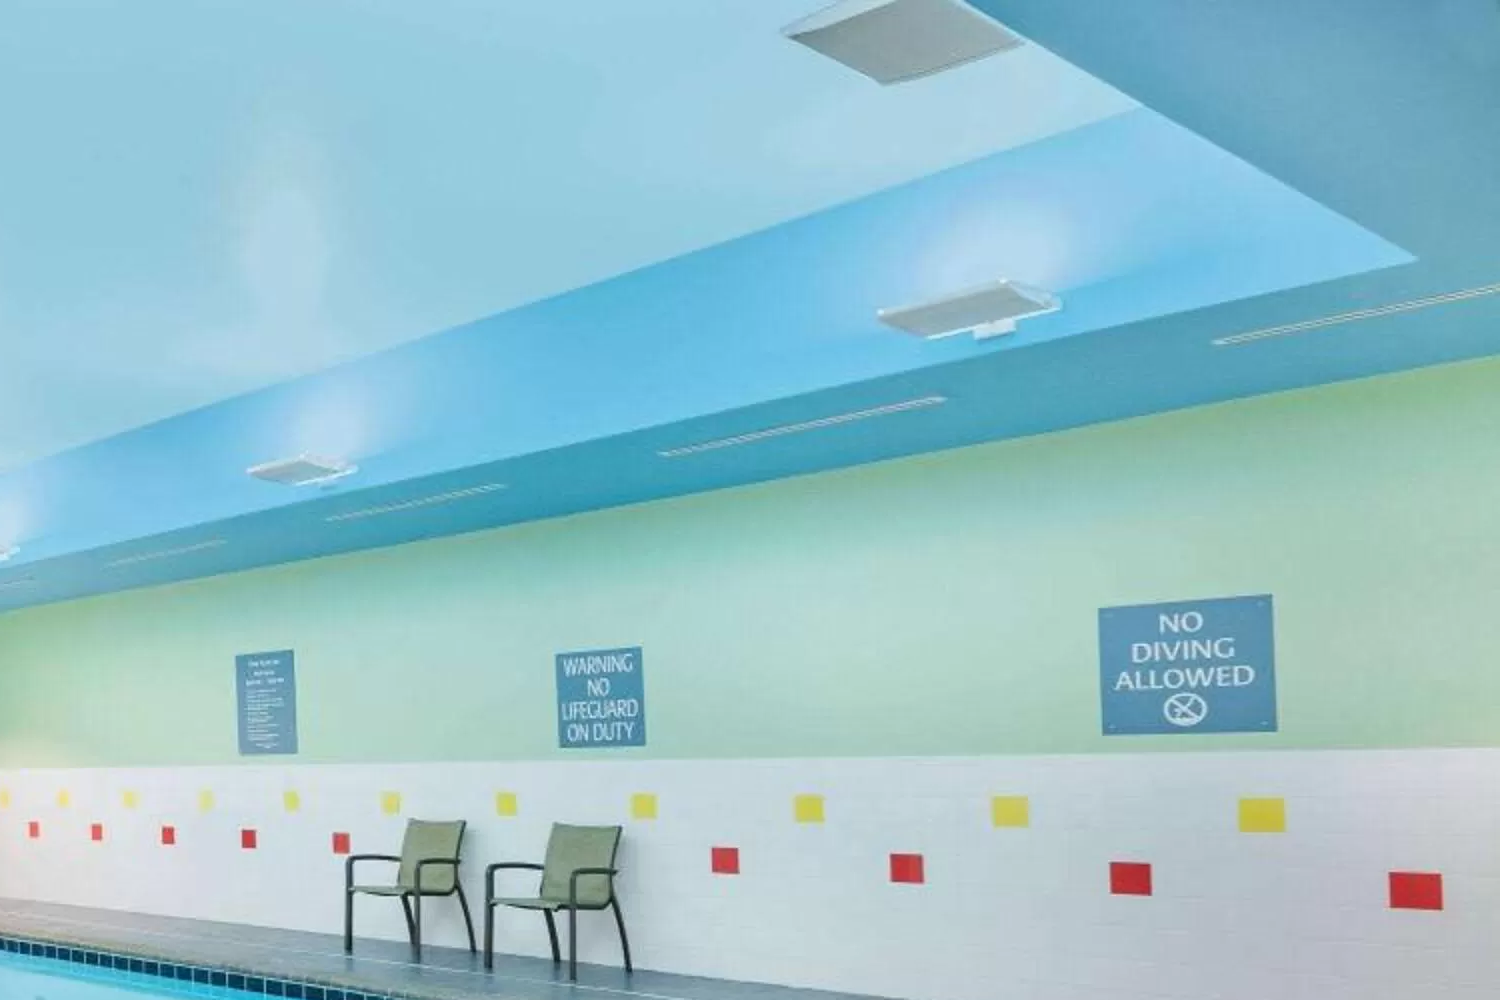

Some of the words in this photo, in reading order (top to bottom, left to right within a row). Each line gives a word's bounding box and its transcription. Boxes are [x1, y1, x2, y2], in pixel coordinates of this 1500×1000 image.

[1158, 611, 1204, 634] NO
[1131, 637, 1235, 663] DIVING
[562, 653, 634, 678] WARNING
[587, 677, 611, 697] NO
[1113, 664, 1256, 692] ALLOWED
[561, 698, 639, 721] LIFEGUARD
[567, 722, 589, 742] ON
[593, 721, 635, 742] DUTY
